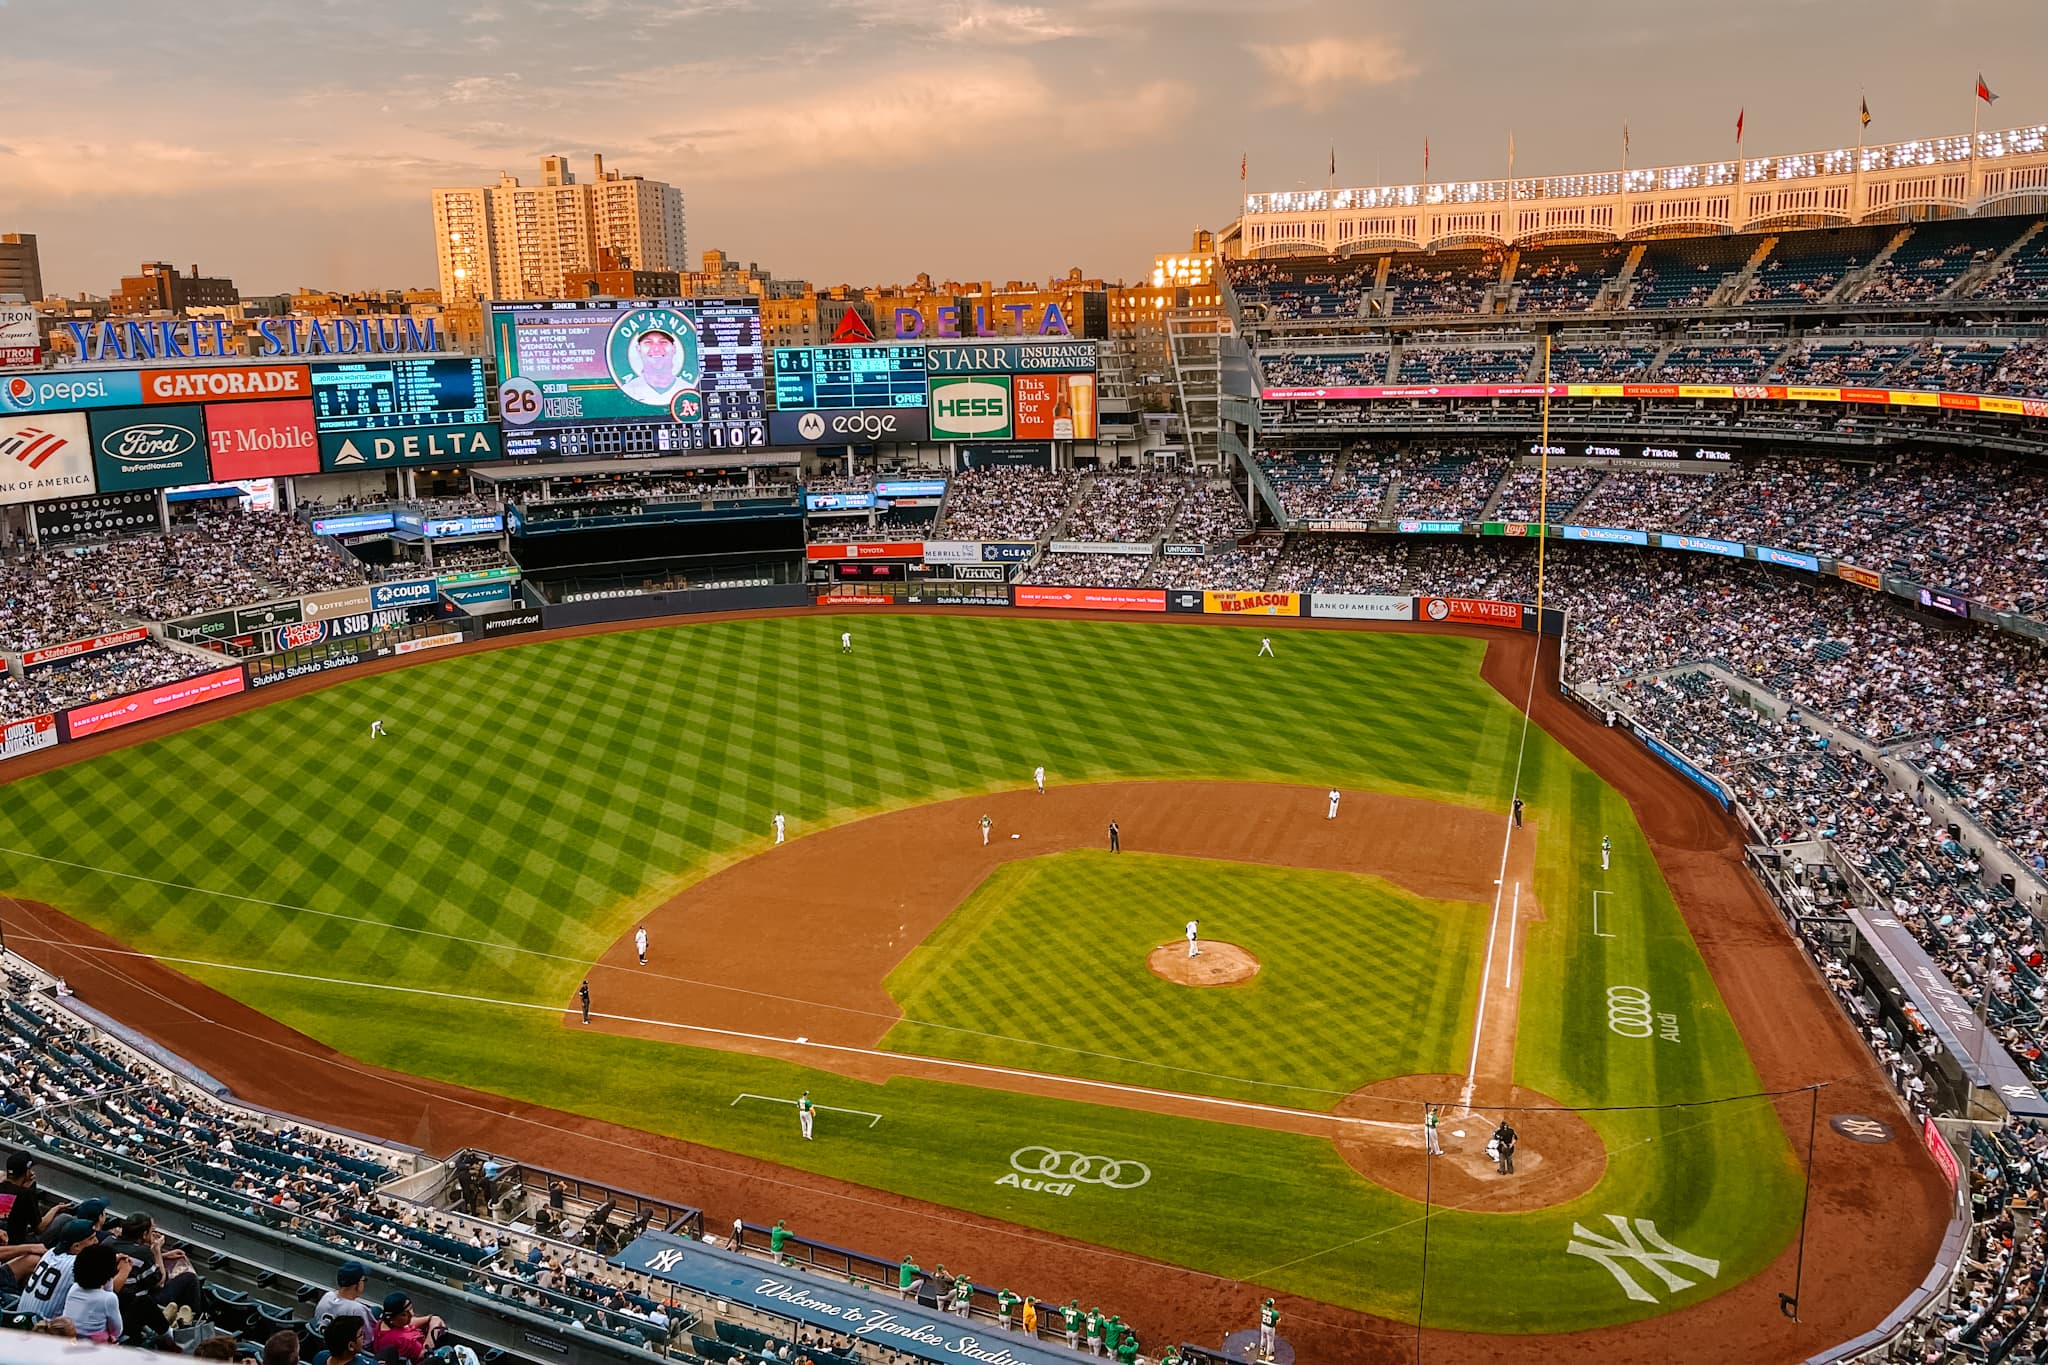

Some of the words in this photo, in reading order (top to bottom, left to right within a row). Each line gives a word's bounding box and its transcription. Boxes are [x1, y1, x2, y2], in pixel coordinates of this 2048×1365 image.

[551, 302, 577, 310] SINKER
[517, 317, 536, 325] LAST
[894, 303, 1069, 339] DELTA
[67, 320, 237, 361] YANKEE
[258, 317, 438, 357] STADIUM
[518, 328, 538, 336] MADE
[568, 327, 590, 335] DEBUT
[928, 348, 1012, 371] STARR
[1021, 345, 1096, 358] INSURANCE
[1021, 356, 1096, 369] COMPANIES
[40, 378, 105, 402] pepsi
[153, 371, 299, 397] GATORADE
[1017, 379, 1045, 390] This
[504, 389, 538, 415] 26
[1018, 390, 1051, 401] Bud's
[543, 397, 584, 418] NEUSE
[937, 398, 1003, 417] HESS
[1018, 402, 1039, 413] For
[463, 413, 484, 423] 8:13
[832, 410, 897, 441] edge
[1018, 413, 1045, 424] You.
[119, 428, 180, 457] Ford
[236, 427, 315, 452] Mobile
[507, 439, 542, 448] ATHLETICS
[713, 429, 722, 447] 1
[730, 427, 744, 446] 0
[750, 426, 763, 445] 2
[374, 431, 491, 461] DELTA
[507, 447, 538, 456] YANKEES
[1594, 447, 1621, 456] TikTok
[1651, 448, 1679, 458] TikTok
[1705, 451, 1731, 460] TikTok
[121, 460, 183, 473] BuyFordNow.com
[18, 479, 33, 491] OF
[36, 474, 91, 488] AMERICA
[1308, 521, 1330, 529] Parts
[1330, 521, 1368, 529] Authority
[1002, 548, 1032, 557] CLEAR
[908, 563, 931, 572] FedEx
[956, 566, 1001, 580] VIKING
[393, 584, 430, 598] coupa
[467, 589, 503, 599] AMTRAK
[320, 602, 342, 610] LOTTE
[1314, 602, 1336, 610] BANK
[1338, 603, 1350, 611] OF
[1351, 604, 1391, 612] AMERICA
[1450, 601, 1475, 613] F.W.
[1478, 603, 1518, 618] WEBB
[178, 627, 202, 639] Uber
[201, 621, 225, 634] Eats
[285, 619, 321, 637] Jersey
[332, 623, 341, 637] A
[344, 614, 370, 633] SUB
[371, 608, 410, 630] ABOVE
[486, 614, 540, 630] NITTOTIRE.COM
[253, 669, 285, 688] StubHub
[287, 662, 321, 679] StubHub
[323, 654, 359, 669] StubHub
[1656, 1012, 1681, 1043] Audi
[994, 1173, 1076, 1197] Audi
[1566, 1213, 1721, 1305] NY
[24, 1260, 62, 1301] 99
[958, 1290, 969, 1299] 77
[755, 1278, 841, 1317] Welcome
[844, 1307, 865, 1322] to
[855, 1309, 944, 1347] Yankee
